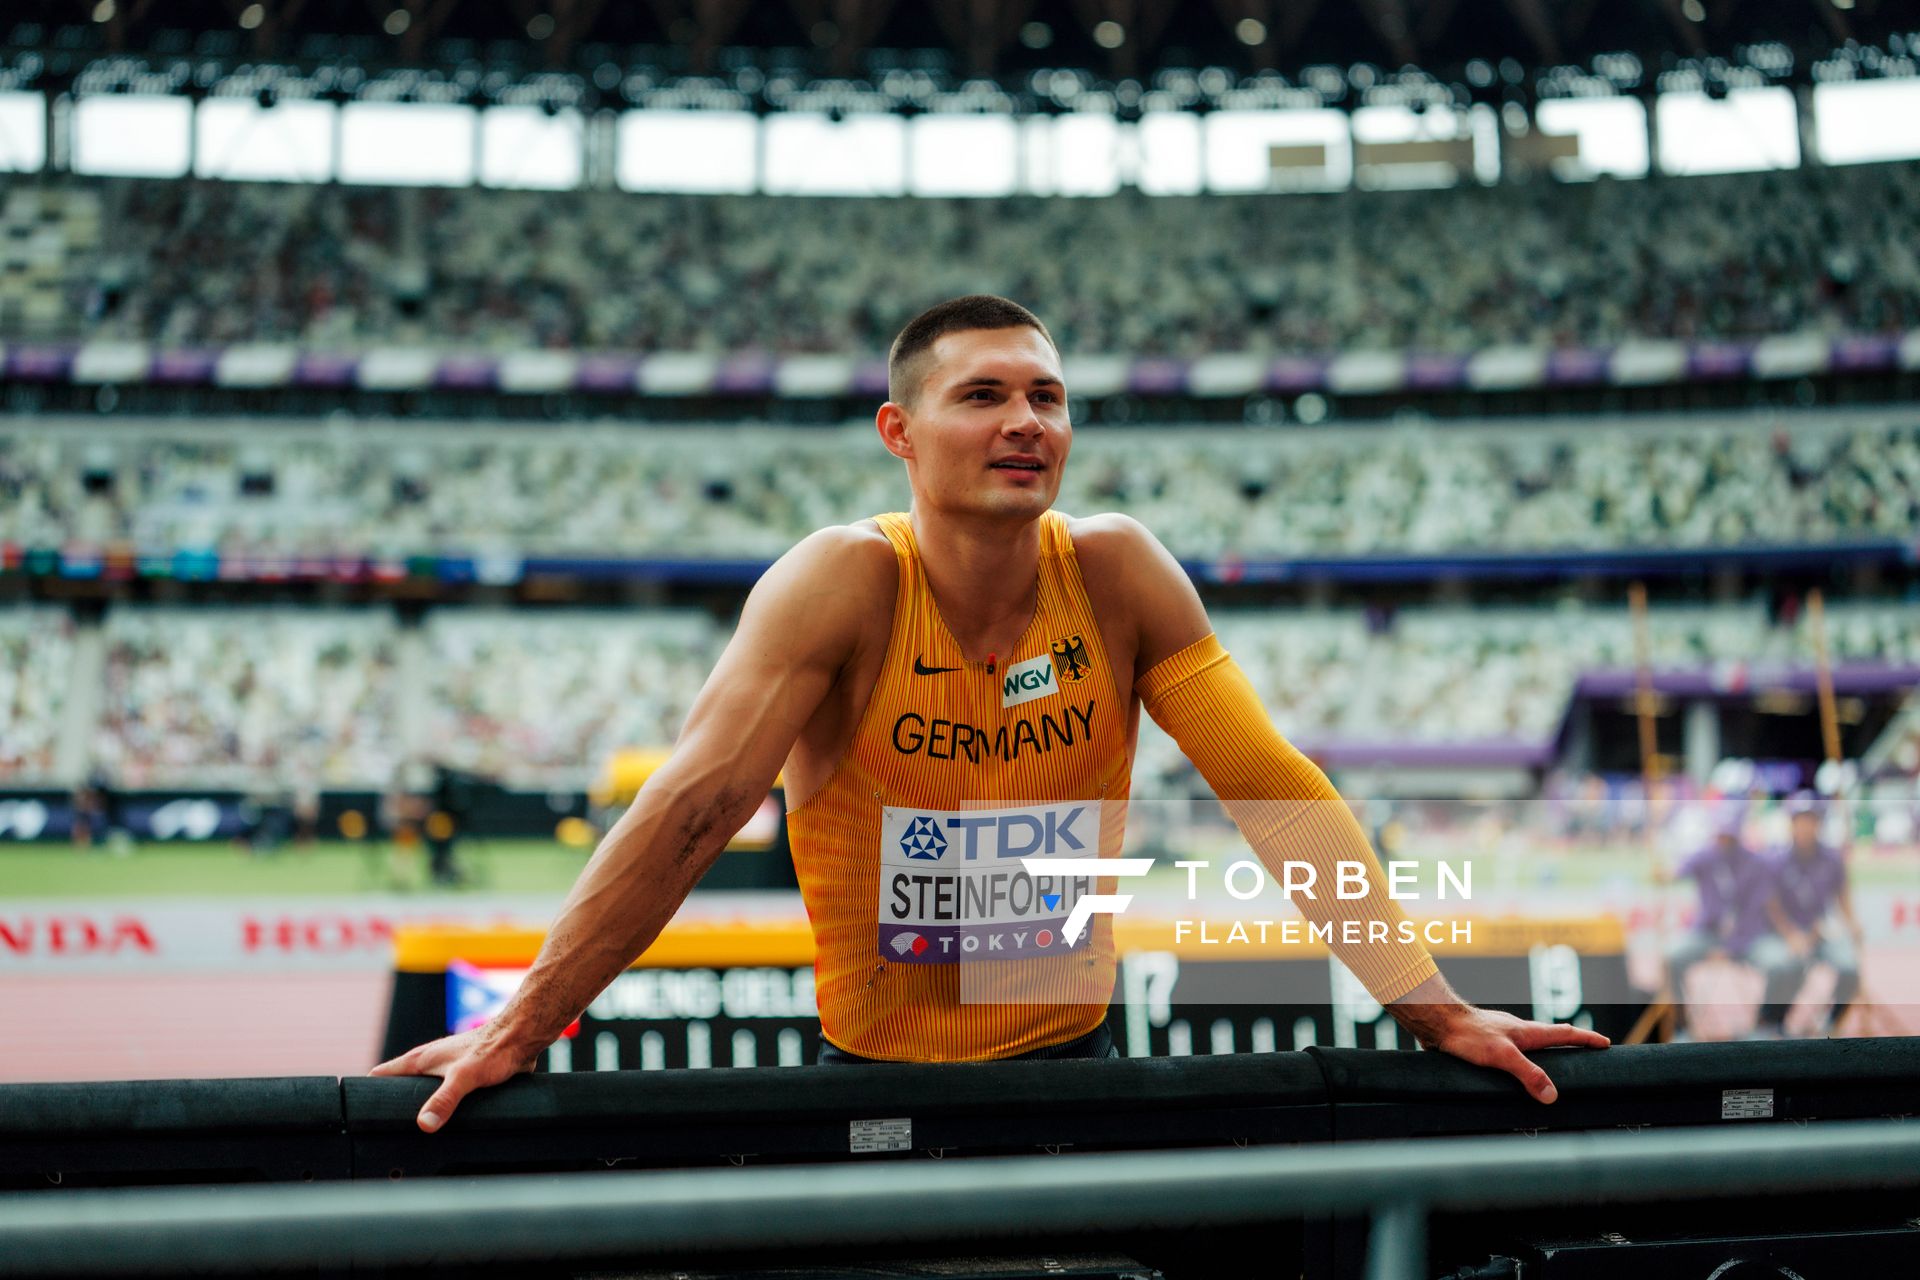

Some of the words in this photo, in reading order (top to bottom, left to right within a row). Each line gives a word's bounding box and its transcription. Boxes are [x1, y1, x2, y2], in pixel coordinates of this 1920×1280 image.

[1003, 664, 1053, 697] WGV
[892, 700, 1095, 764] GERMANY
[946, 807, 1086, 861] TDK
